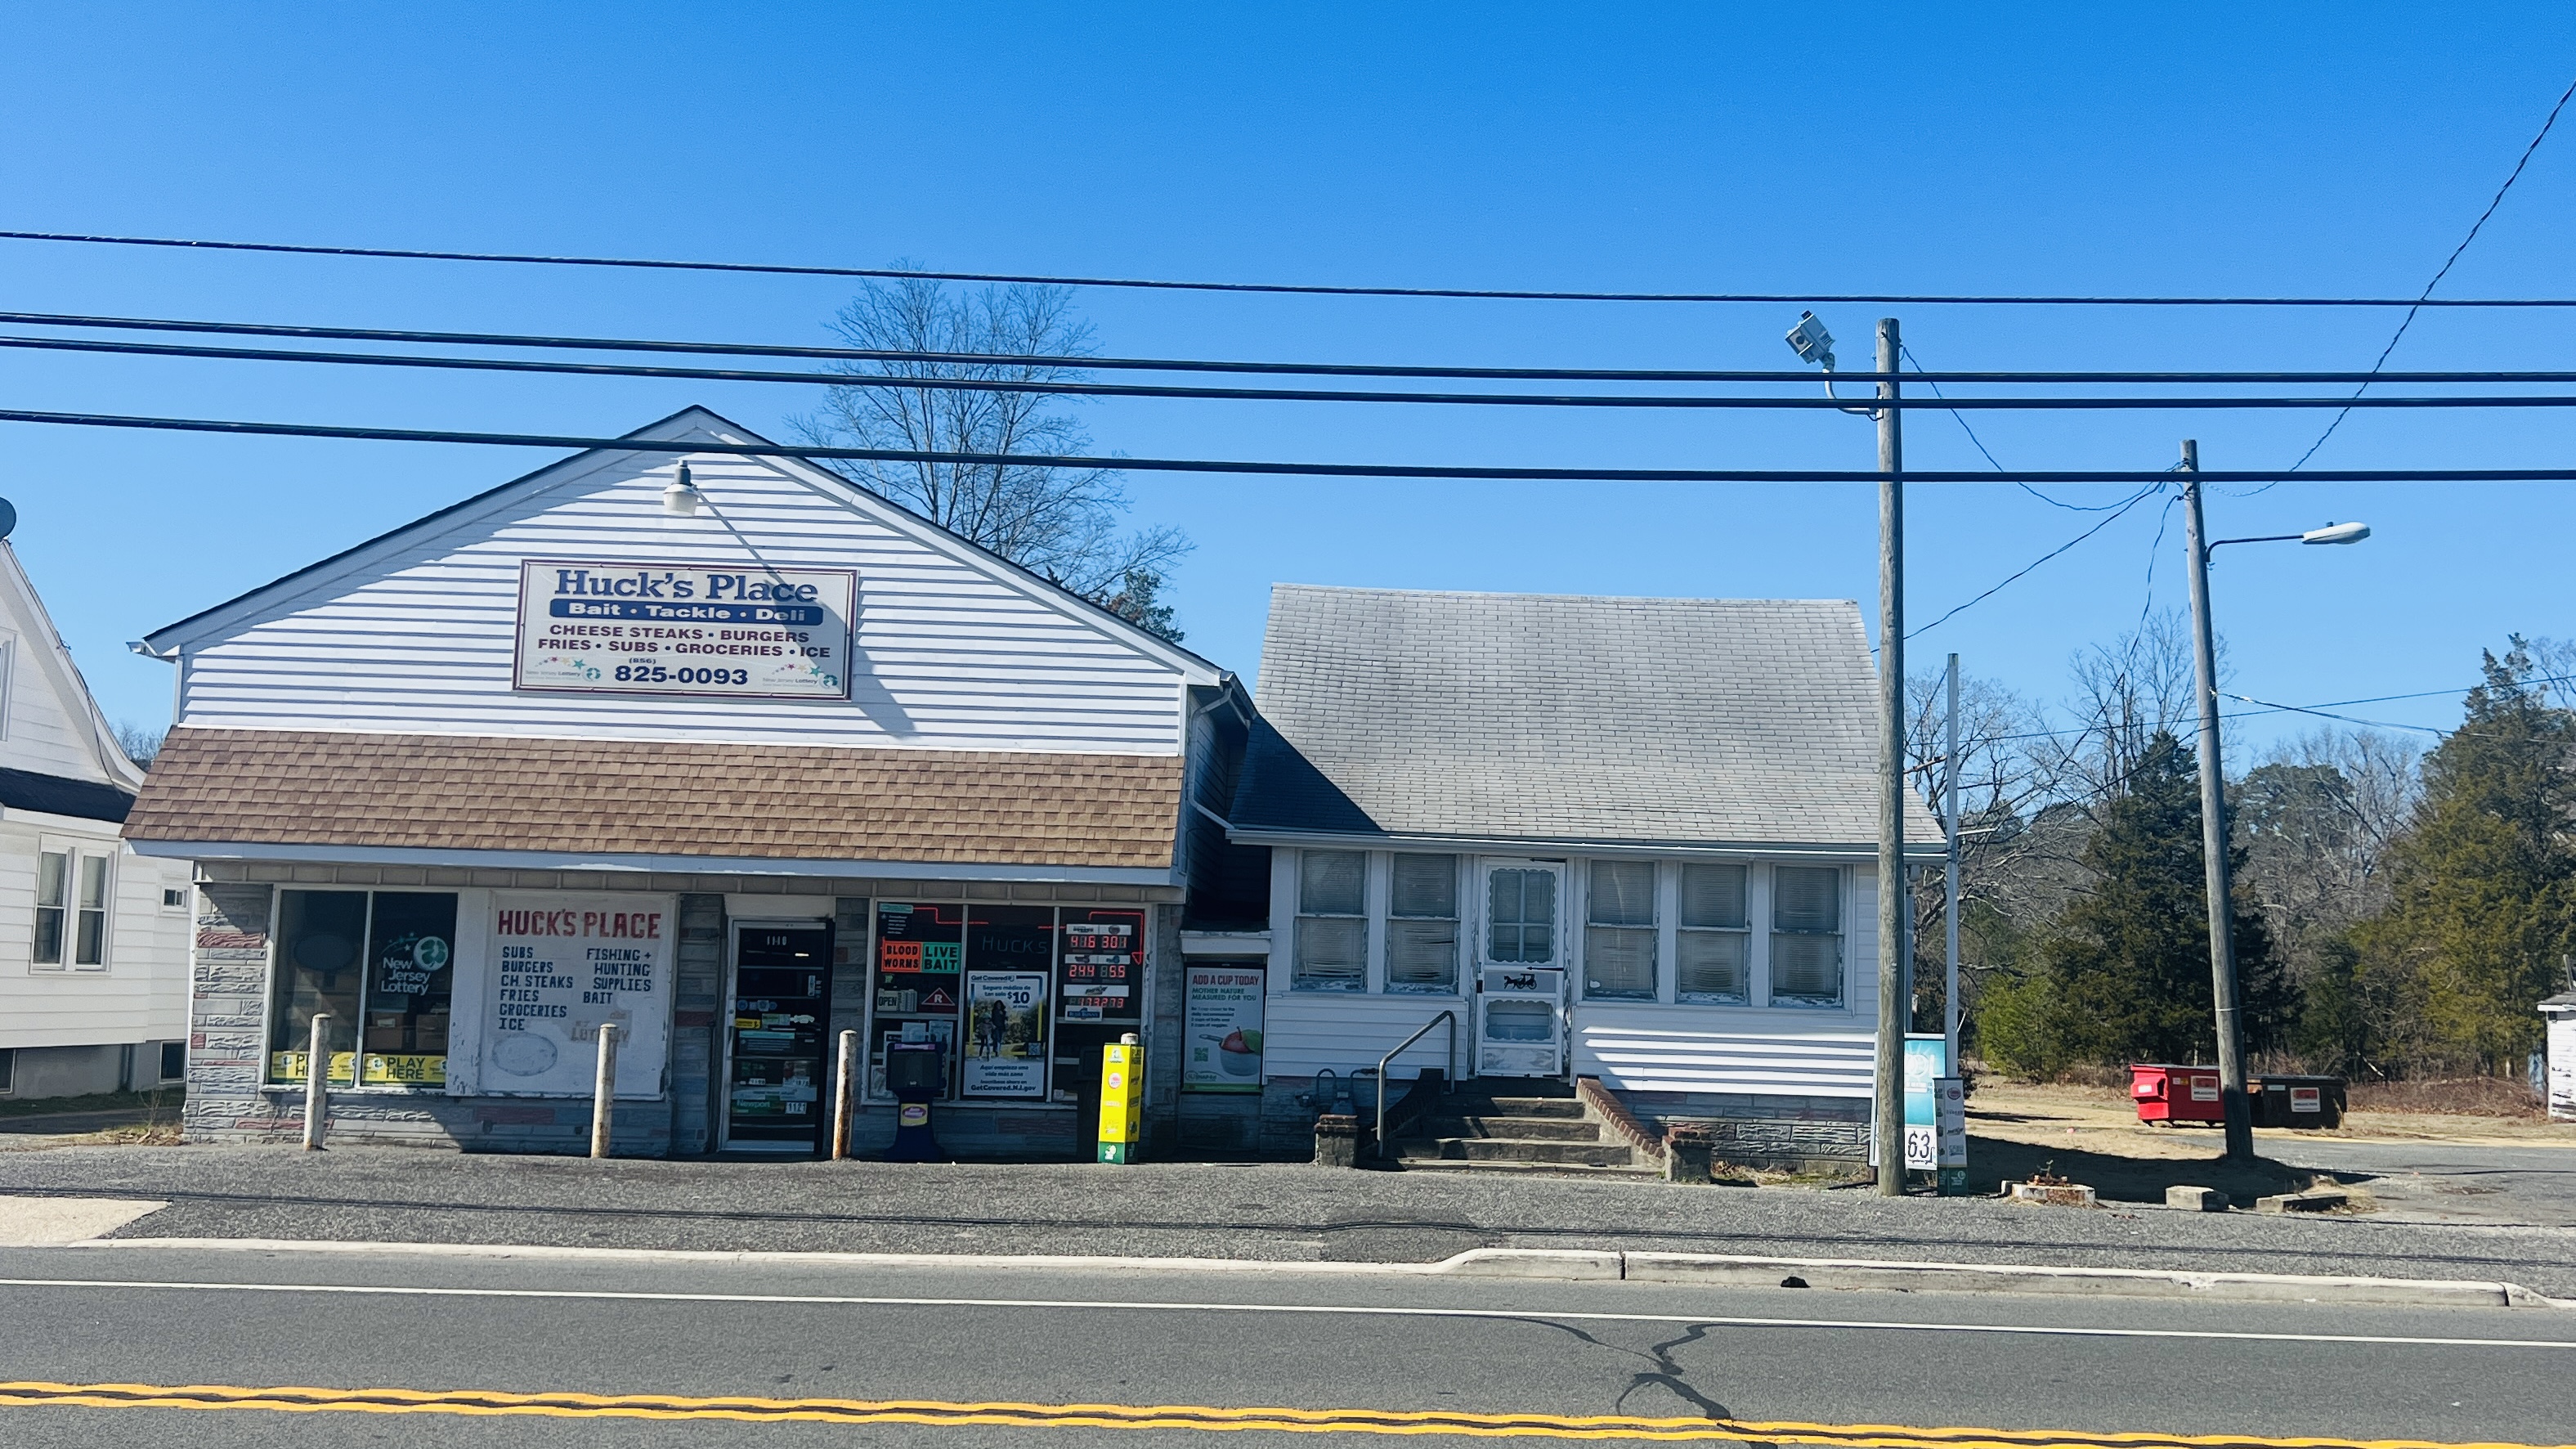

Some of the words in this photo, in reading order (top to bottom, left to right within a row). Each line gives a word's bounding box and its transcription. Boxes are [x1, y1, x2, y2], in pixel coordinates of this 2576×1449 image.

[554, 570, 694, 599] Huck's
[706, 574, 818, 603] Place
[568, 603, 621, 616] Bait
[645, 605, 732, 619] Tackle
[755, 608, 805, 621] Deli
[549, 625, 624, 636] CHEESE
[629, 627, 703, 639] STEAKS
[720, 630, 809, 643] BURGERS
[538, 639, 591, 650] FRIES
[608, 641, 658, 653] SUBS
[675, 644, 783, 656] GROCERIES
[800, 647, 831, 657] ICE
[615, 665, 748, 685] 825-0093
[497, 908, 577, 936] HUCK'S
[583, 912, 661, 940] PLACE
[983, 935, 1047, 954] HUCKS
[1071, 935, 1095, 948] 416
[1102, 935, 1127, 949] 301
[502, 945, 534, 959] SUBS
[586, 948, 640, 961] FISHING
[886, 945, 918, 955] BLOOD
[925, 945, 958, 958] LIVE
[383, 957, 414, 969] New
[501, 960, 553, 973] BURGERS
[594, 962, 651, 976] HUNTING
[884, 958, 919, 969] WORMS
[924, 959, 958, 971] BAIT
[388, 968, 431, 984] Jersey
[1069, 965, 1095, 977] 244
[1109, 966, 1125, 978] 55
[525, 976, 573, 989] STEAKS
[593, 976, 652, 992] SUPPLIES
[1193, 975, 1208, 985] ADD
[1211, 975, 1216, 985] A
[1218, 975, 1233, 985] CUP
[1234, 976, 1259, 986] TODAY
[381, 980, 429, 996] Lottery
[500, 989, 540, 1003] FRIES
[583, 991, 613, 1004] BAIT
[878, 996, 898, 1007] OPEN
[934, 994, 943, 1003] R
[1007, 991, 1030, 1004] $10
[499, 1003, 568, 1018] GROCERIES
[498, 1017, 526, 1030] ICE
[388, 1056, 425, 1068] PLAY
[387, 1068, 424, 1079] HERE
